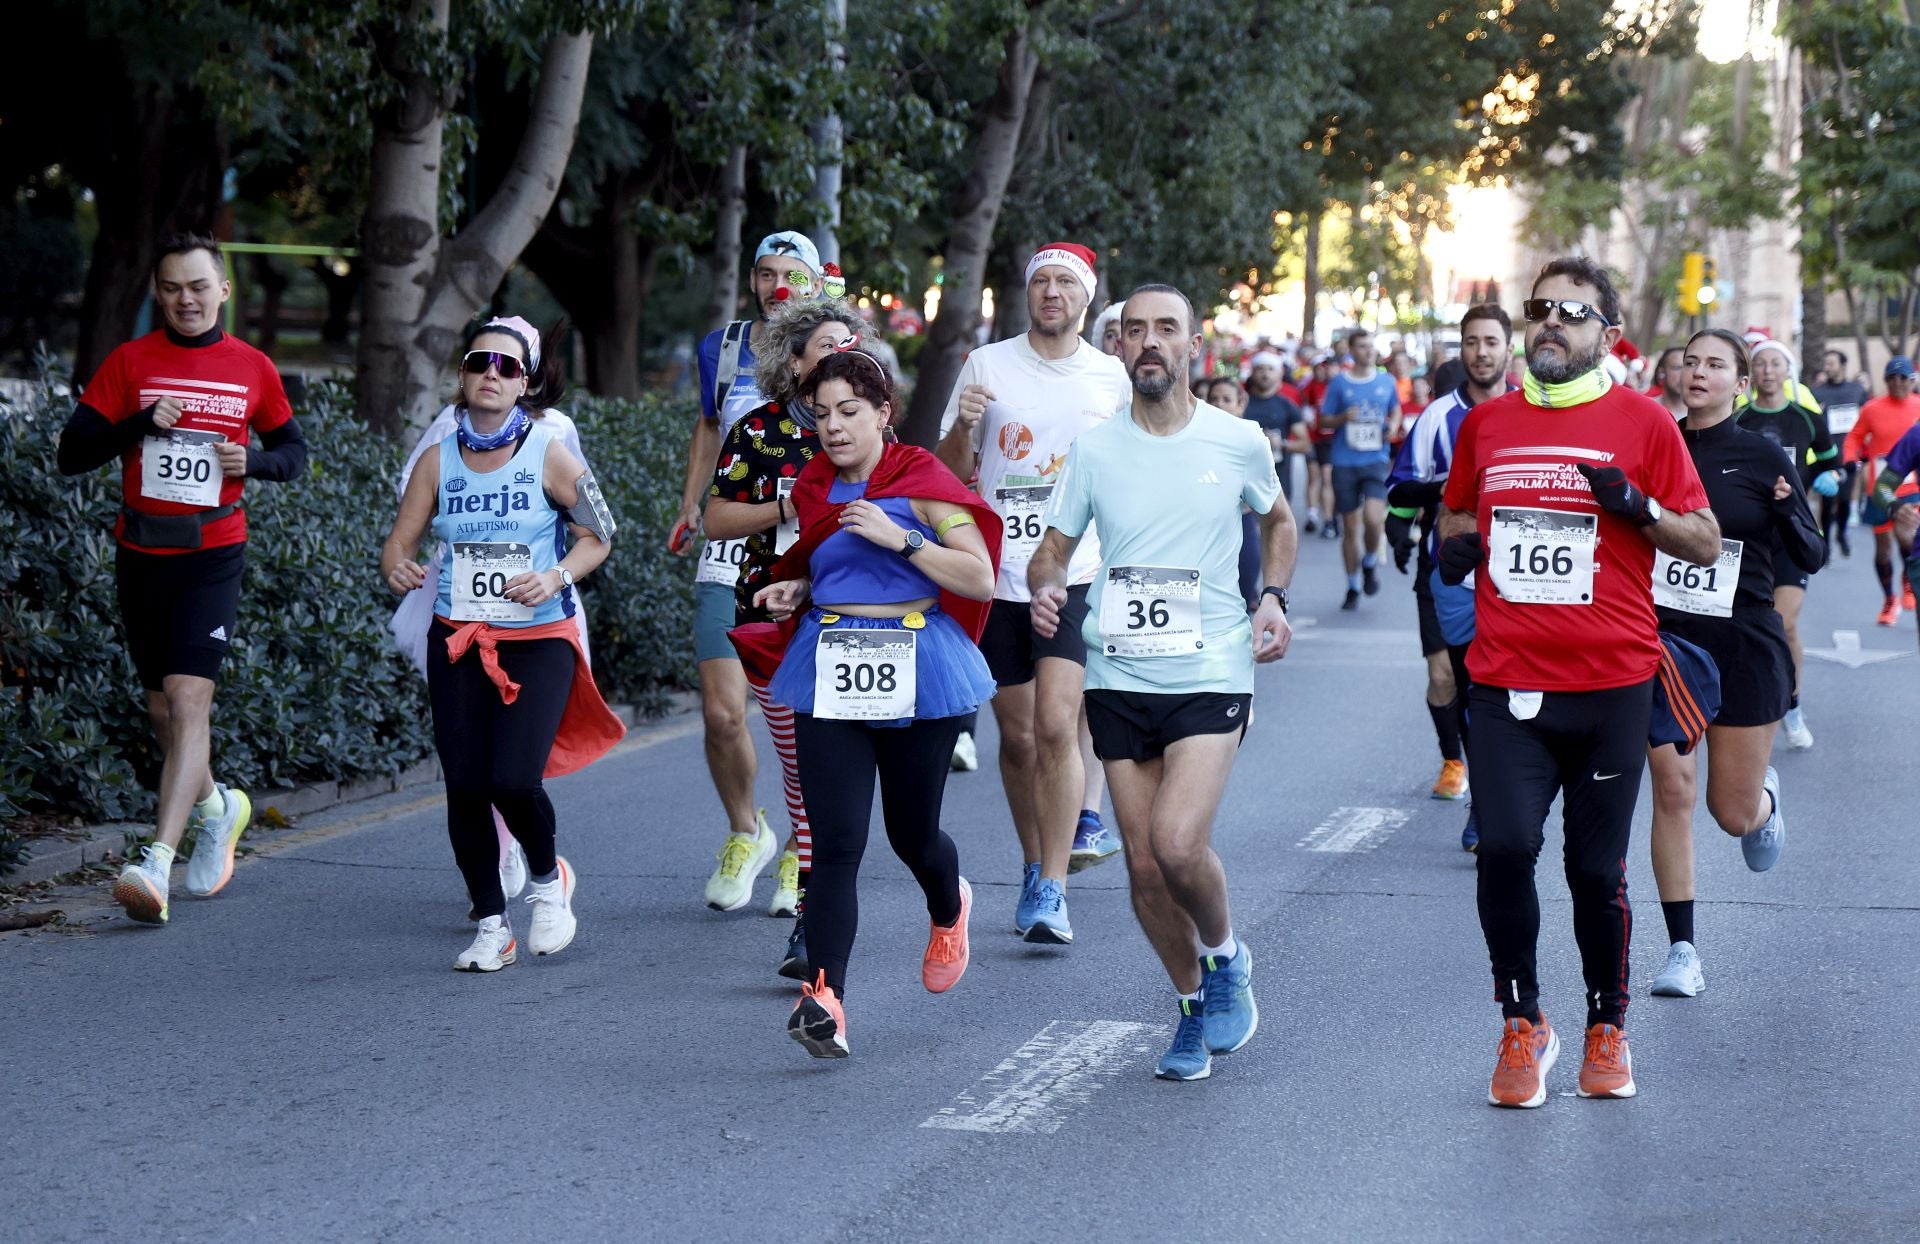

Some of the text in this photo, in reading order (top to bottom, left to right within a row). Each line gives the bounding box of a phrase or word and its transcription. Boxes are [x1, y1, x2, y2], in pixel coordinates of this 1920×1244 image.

[207, 393, 248, 408] CARRERA
[202, 405, 246, 419] PALMILLA
[1598, 451, 1615, 462] XIV
[157, 454, 211, 483] 390
[1538, 471, 1558, 480] SAN
[1510, 480, 1550, 489] PALMA
[446, 484, 531, 518] nerja
[456, 520, 519, 534] ATLETISMO
[1508, 543, 1574, 576] 166
[1666, 560, 1718, 593] 661
[1127, 598, 1170, 630] 36
[835, 663, 897, 693] 308
